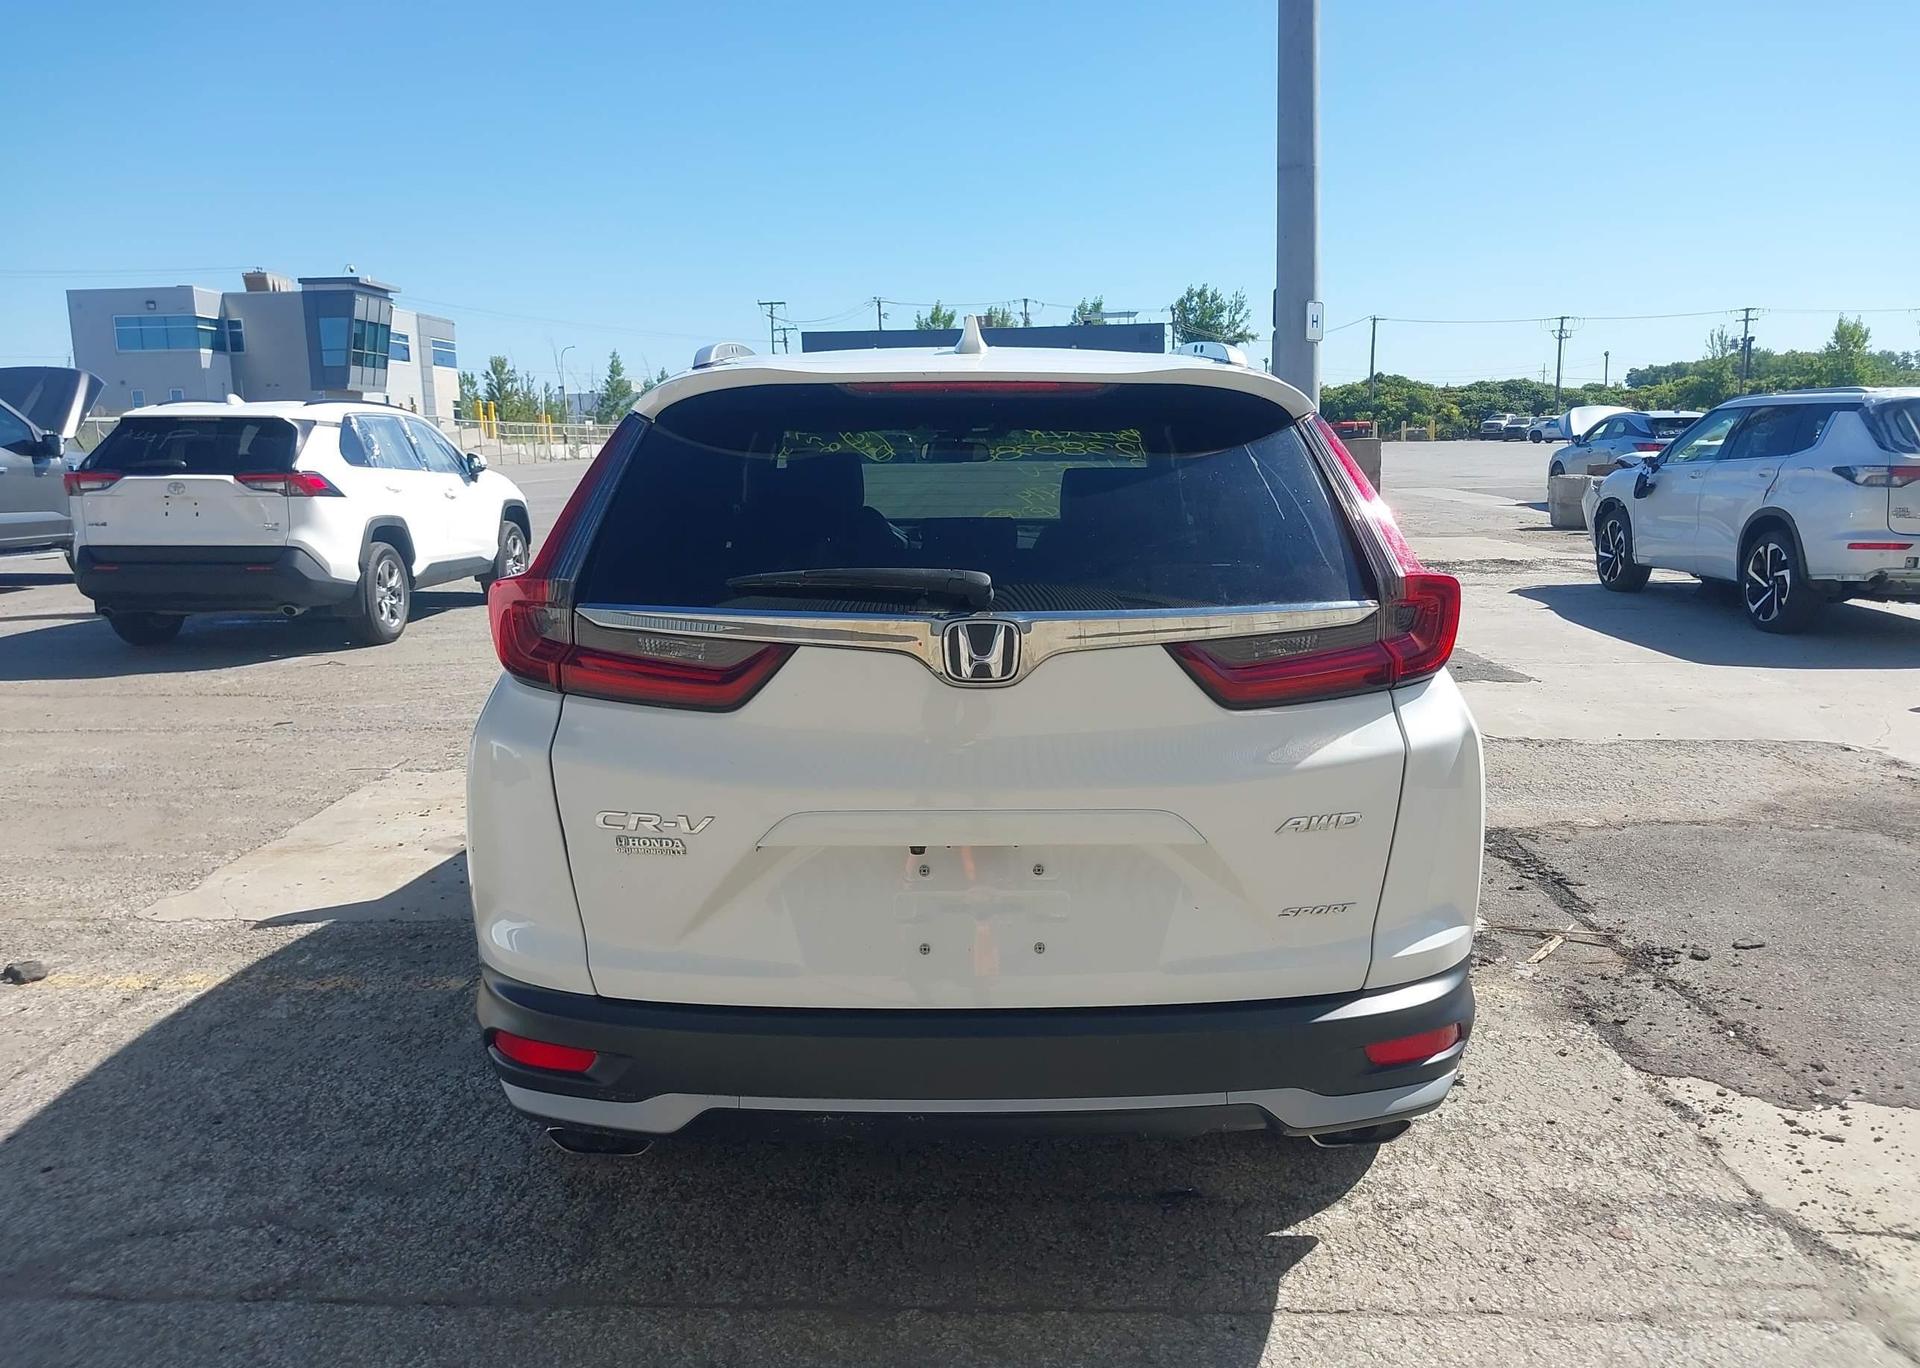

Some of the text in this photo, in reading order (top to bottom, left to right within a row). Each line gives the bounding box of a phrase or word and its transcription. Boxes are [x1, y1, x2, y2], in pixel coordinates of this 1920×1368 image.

[1311, 313, 1319, 329] H
[595, 810, 716, 835] CR-V
[1274, 811, 1363, 834] AWD
[628, 837, 685, 849] HONDA
[1278, 902, 1357, 917] SPORT
